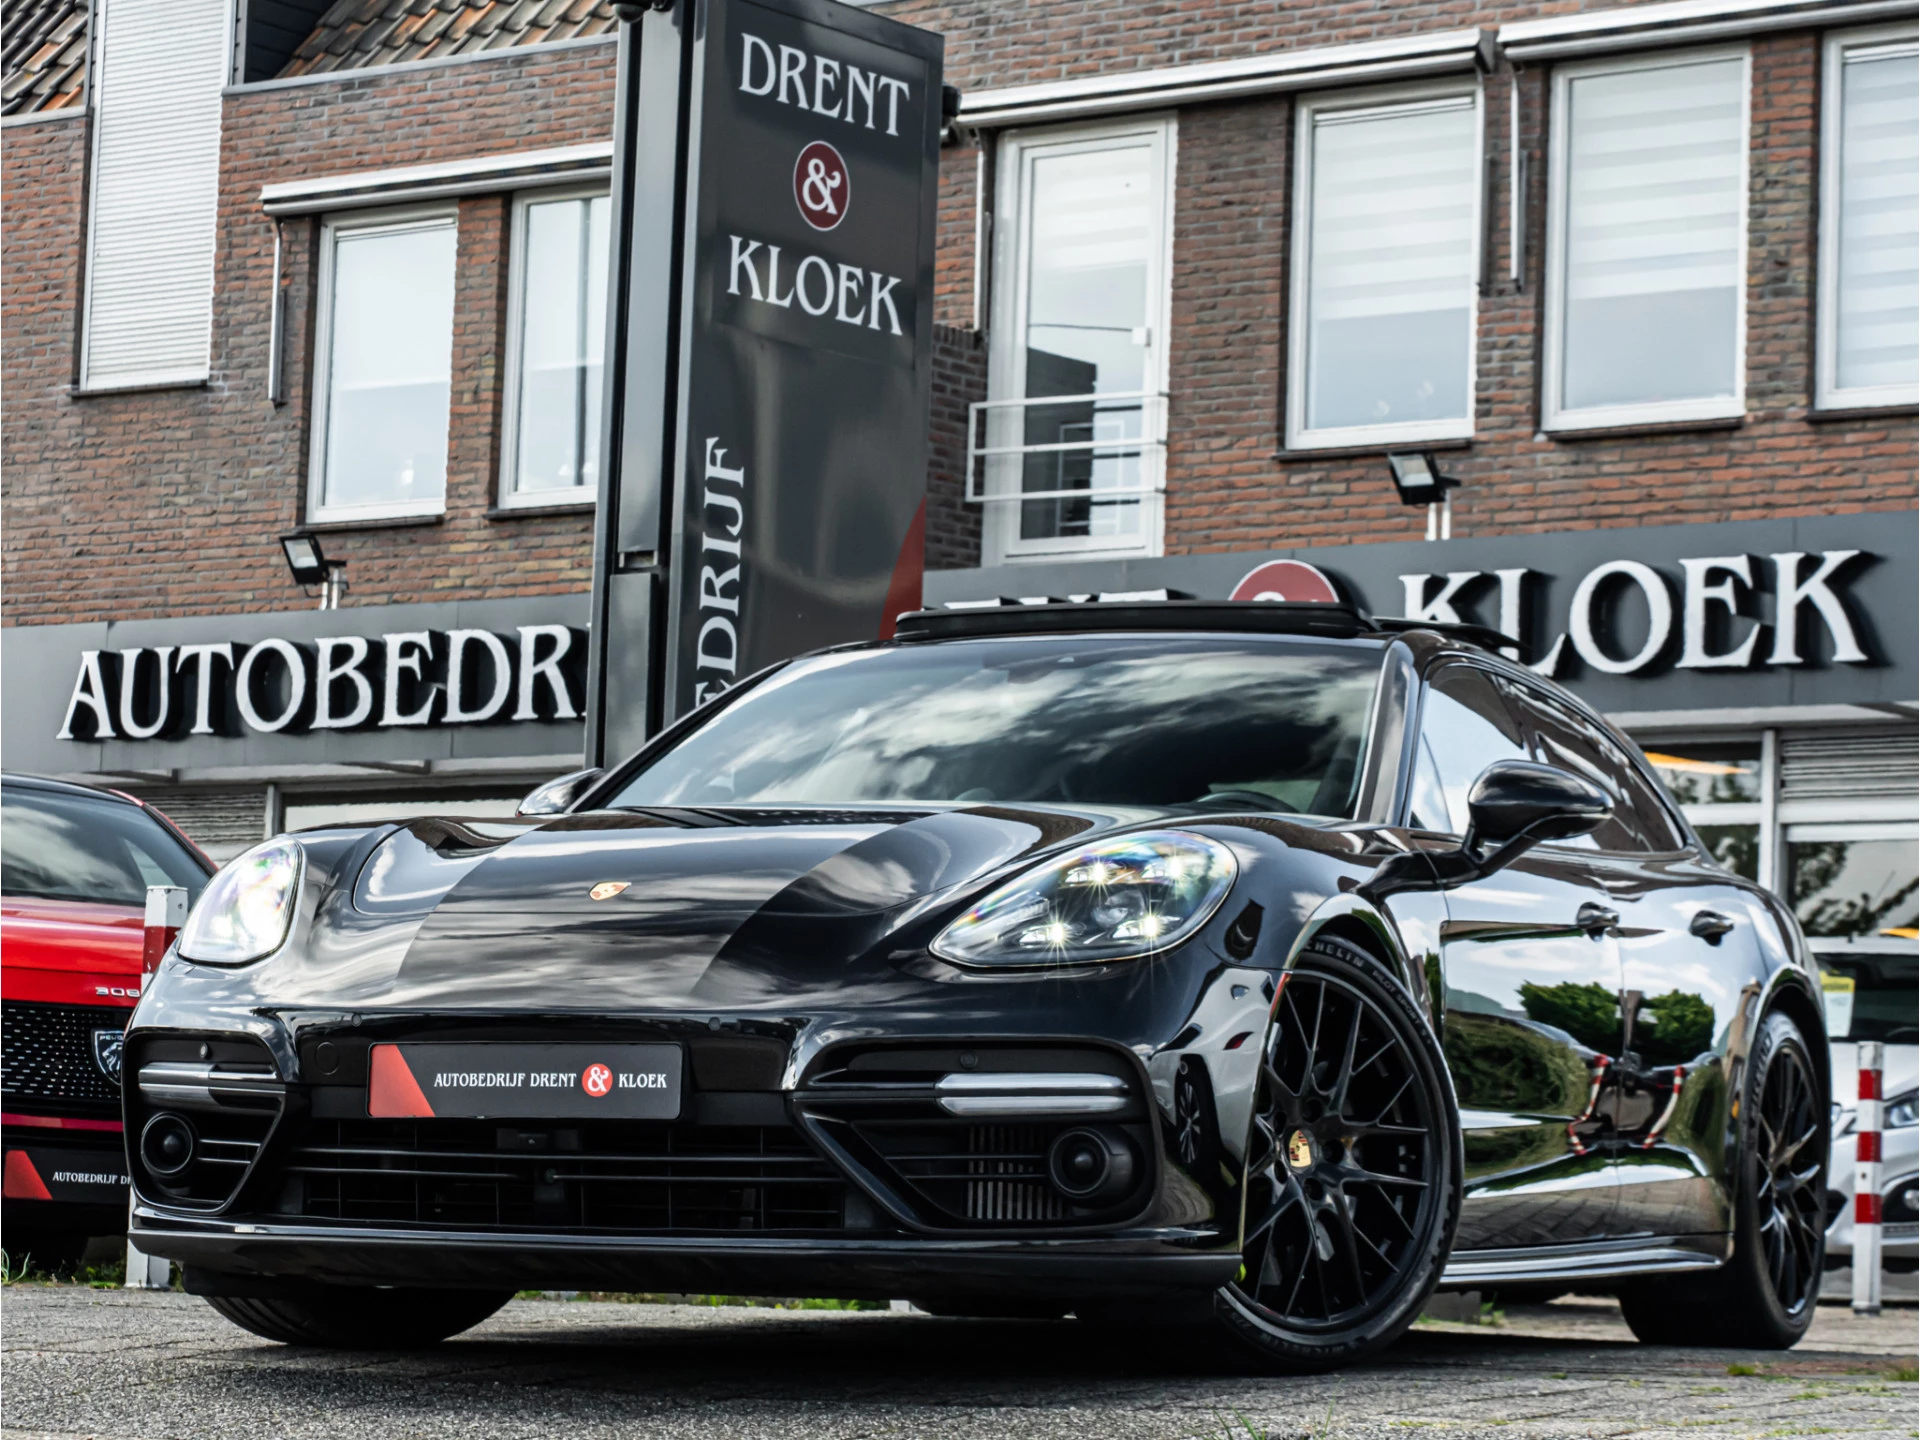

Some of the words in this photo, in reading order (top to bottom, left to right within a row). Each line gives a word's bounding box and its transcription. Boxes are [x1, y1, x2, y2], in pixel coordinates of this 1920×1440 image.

[739, 33, 910, 136] DRENT
[803, 158, 841, 215] &
[727, 235, 903, 336] KLOEK
[56, 622, 591, 740] AUTOBEDR
[95, 986, 140, 998] 308
[434, 1072, 525, 1087] AUTOBEDRIJF
[530, 1072, 577, 1088] DRENT
[587, 1066, 609, 1092] &
[618, 1073, 667, 1088] KLOEK
[52, 1171, 118, 1184] AUTOBEDRIJF
